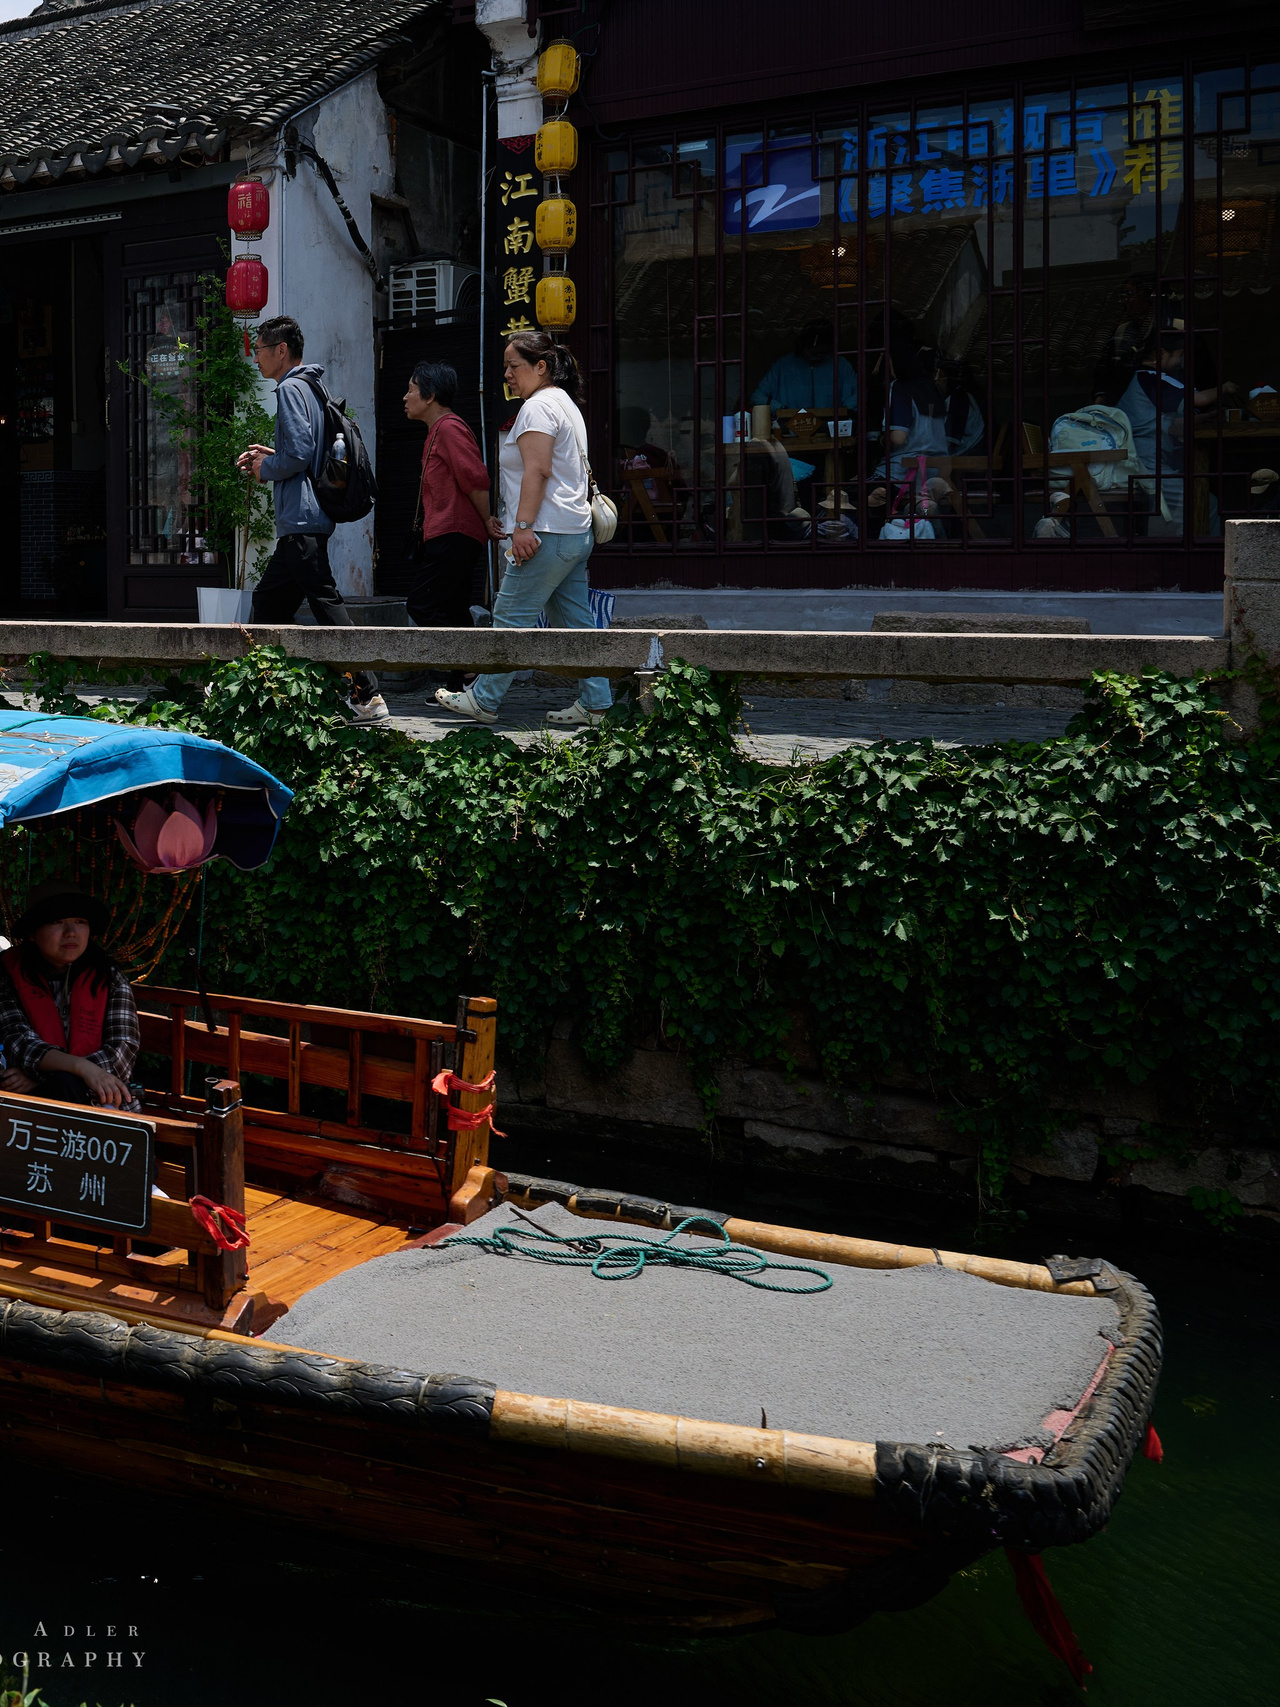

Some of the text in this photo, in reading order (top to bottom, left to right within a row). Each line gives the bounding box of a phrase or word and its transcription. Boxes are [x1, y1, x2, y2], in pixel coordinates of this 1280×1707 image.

[841, 100, 1109, 171] 浙江电视台
[1122, 87, 1184, 195] 推荐
[838, 147, 1118, 223] 《聚焦浙里》
[499, 171, 539, 401] 江南蟹
[6, 1118, 133, 1166] 万三游007
